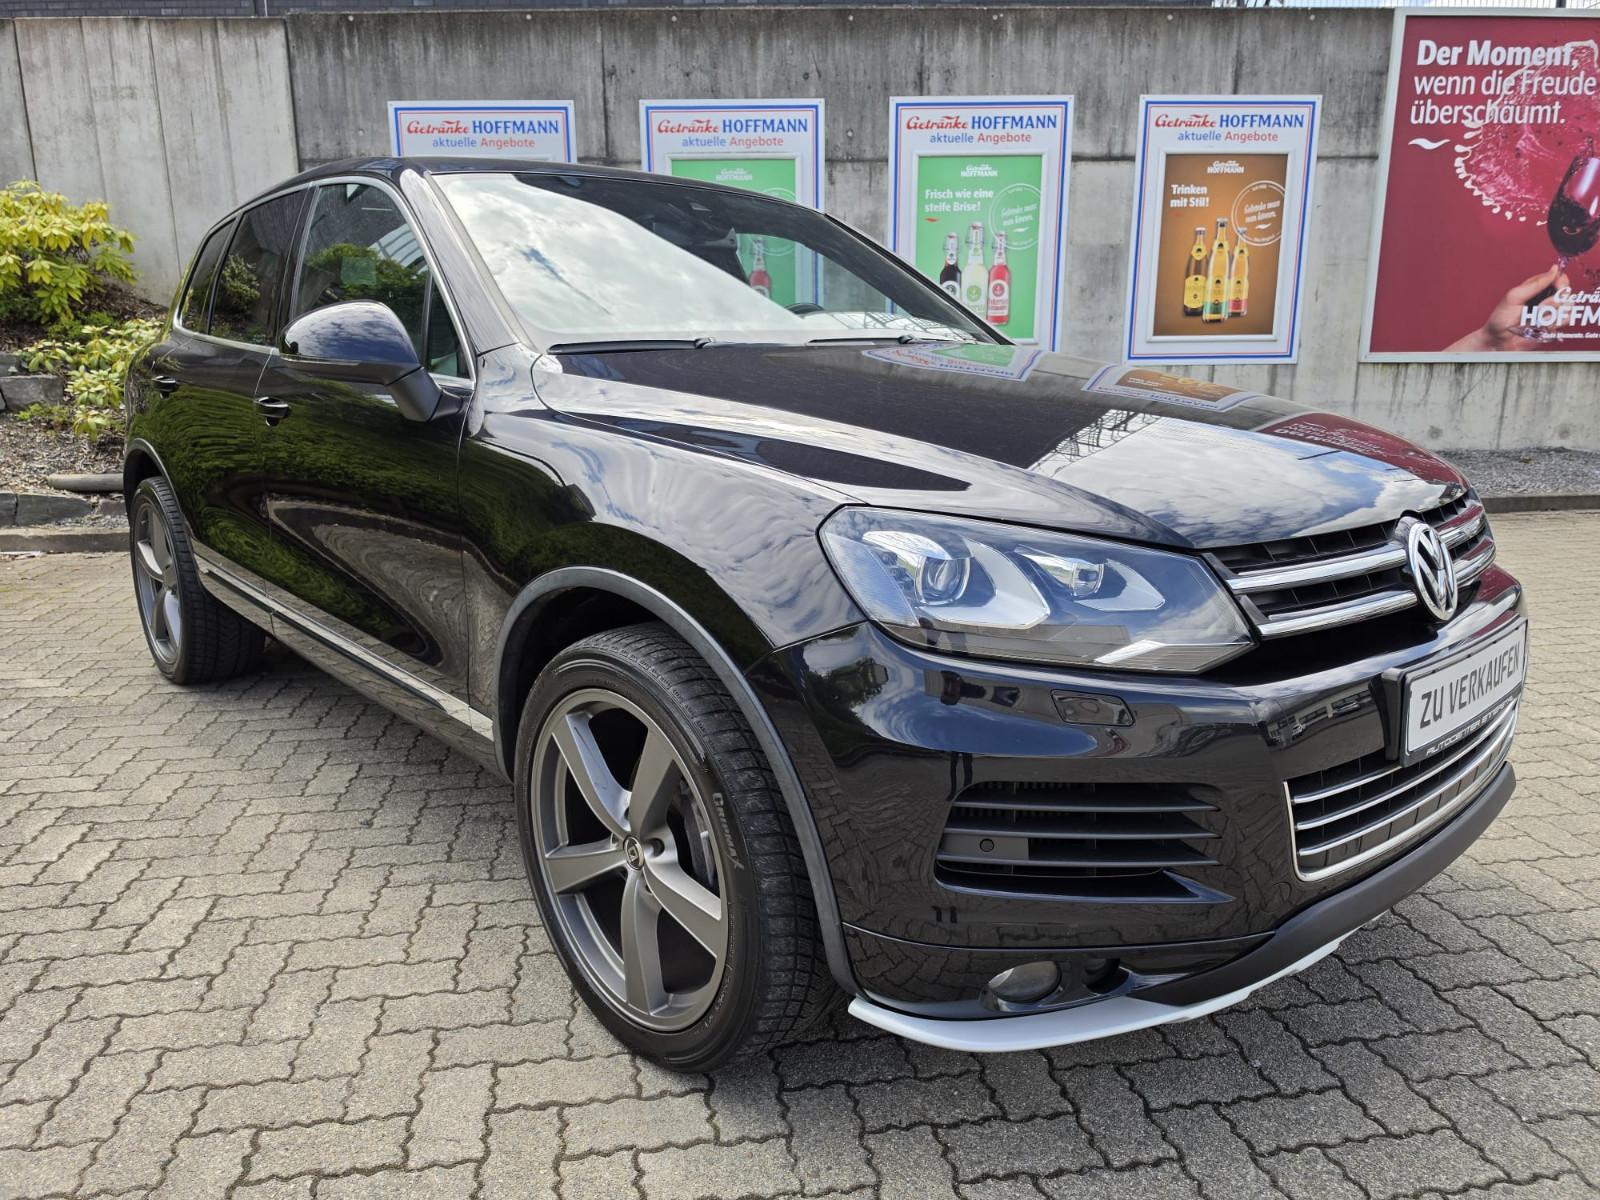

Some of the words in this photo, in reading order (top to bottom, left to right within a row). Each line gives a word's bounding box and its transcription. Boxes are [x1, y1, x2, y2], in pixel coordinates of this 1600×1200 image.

[1416, 40, 1463, 66] Der
[1467, 40, 1580, 69] Moment,
[1413, 74, 1476, 96] wenn
[1481, 70, 1515, 96] die
[1520, 70, 1597, 96] Freude
[1410, 100, 1567, 125] überschäumt.
[406, 119, 470, 135] Getränke
[472, 120, 559, 134] HOFFMANN
[656, 118, 720, 134] Getränke
[722, 118, 808, 133] HOFFMANN
[905, 115, 969, 130] Getränke
[971, 115, 1058, 130] HOFFMANN
[1154, 113, 1217, 129] Getränke
[1219, 113, 1305, 128] HOFFMANN
[432, 136, 478, 148] aktuelle
[480, 136, 536, 150] Angebote
[682, 135, 727, 147] aktuelle
[729, 135, 785, 149] Angebote
[929, 132, 974, 144] aktuelle
[977, 132, 1032, 145] Angebote
[1177, 130, 1222, 142] aktuelle
[1224, 130, 1279, 144] Angebote
[925, 188, 953, 200] Frisch
[955, 188, 972, 199] wie
[974, 188, 994, 199] eine
[1171, 184, 1208, 195] Trinken
[924, 202, 951, 213] steife
[953, 201, 981, 212] Brise!
[1170, 197, 1188, 208] mit
[1189, 196, 1210, 208] Stil!
[1552, 286, 1600, 305] Geträ
[1520, 305, 1600, 327] HOFFM
[1419, 685, 1446, 729] ZU
[1449, 641, 1521, 714] VERKAUFEN
